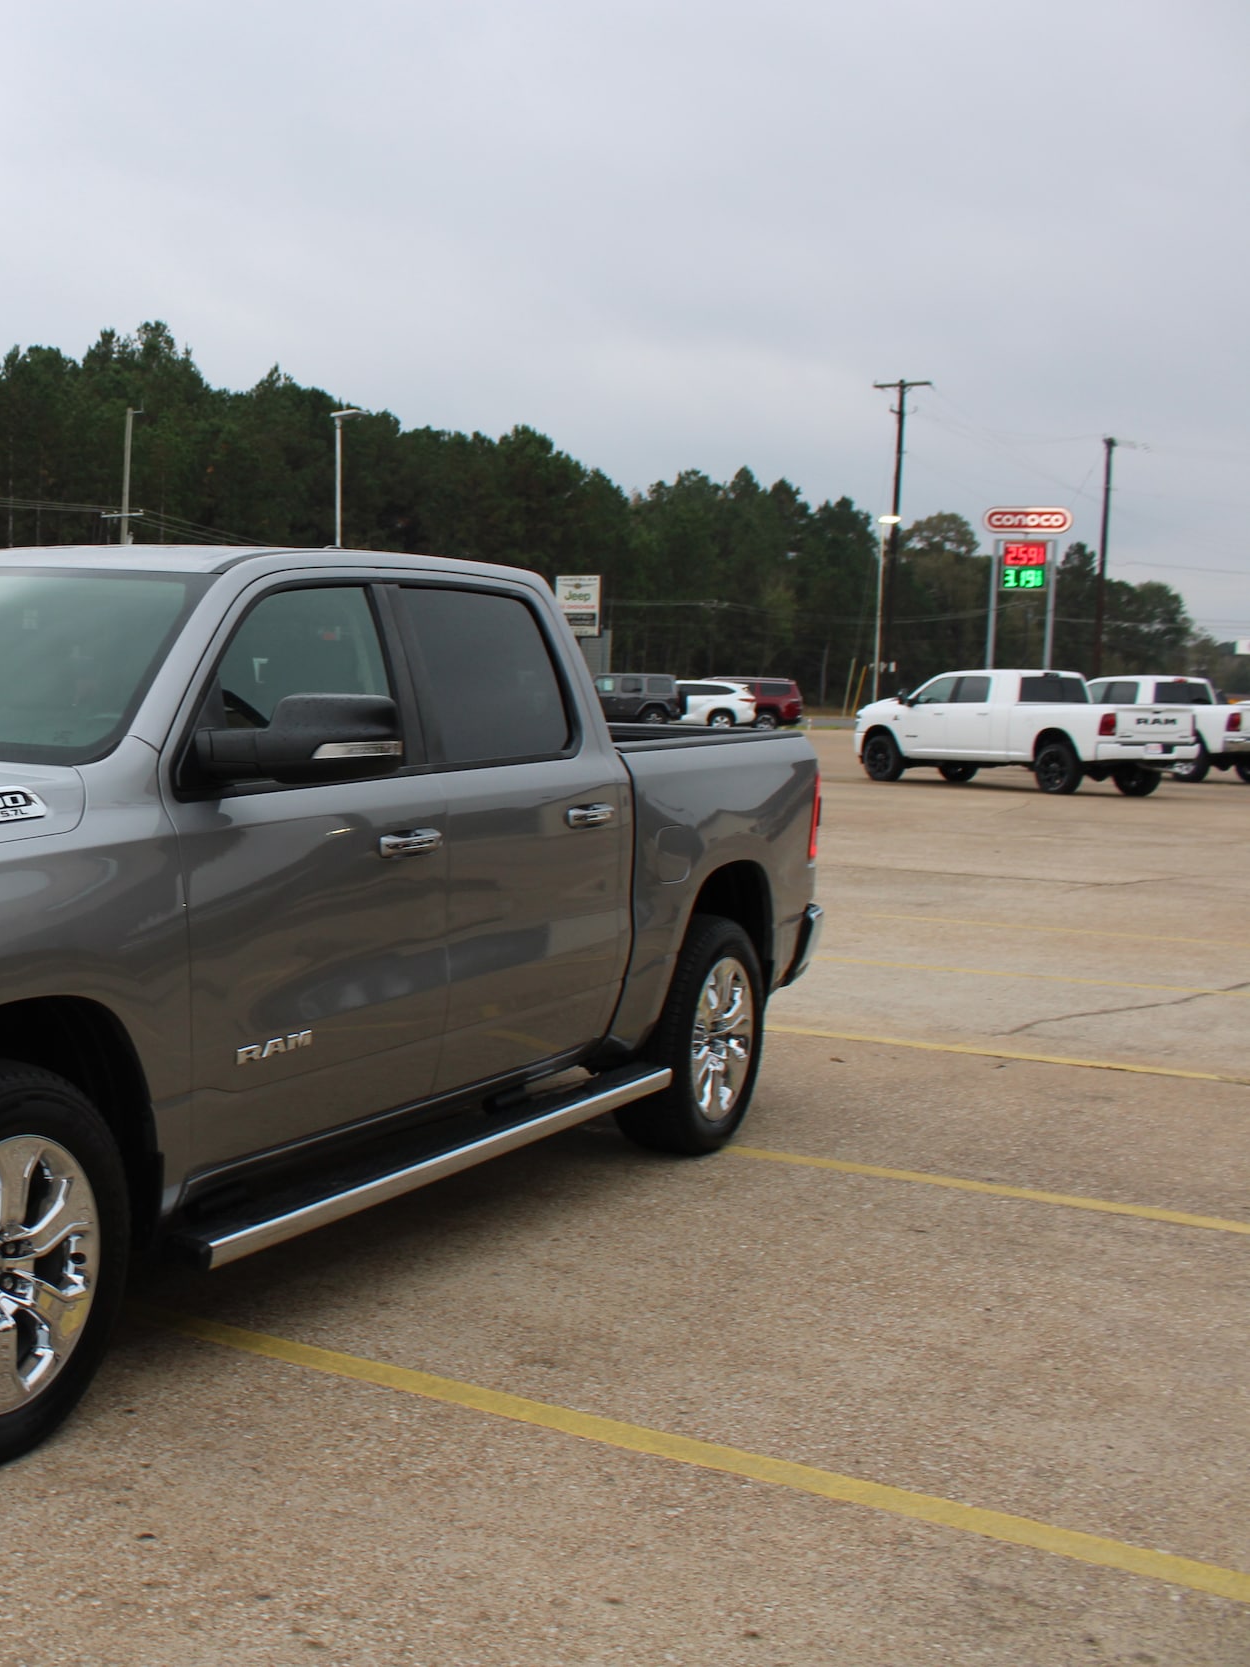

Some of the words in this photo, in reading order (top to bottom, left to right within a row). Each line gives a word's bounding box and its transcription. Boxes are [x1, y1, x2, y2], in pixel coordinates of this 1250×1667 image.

[564, 590, 591, 603] Jeep
[0, 808, 28, 817] 5.7L
[237, 1029, 312, 1065] RAM
